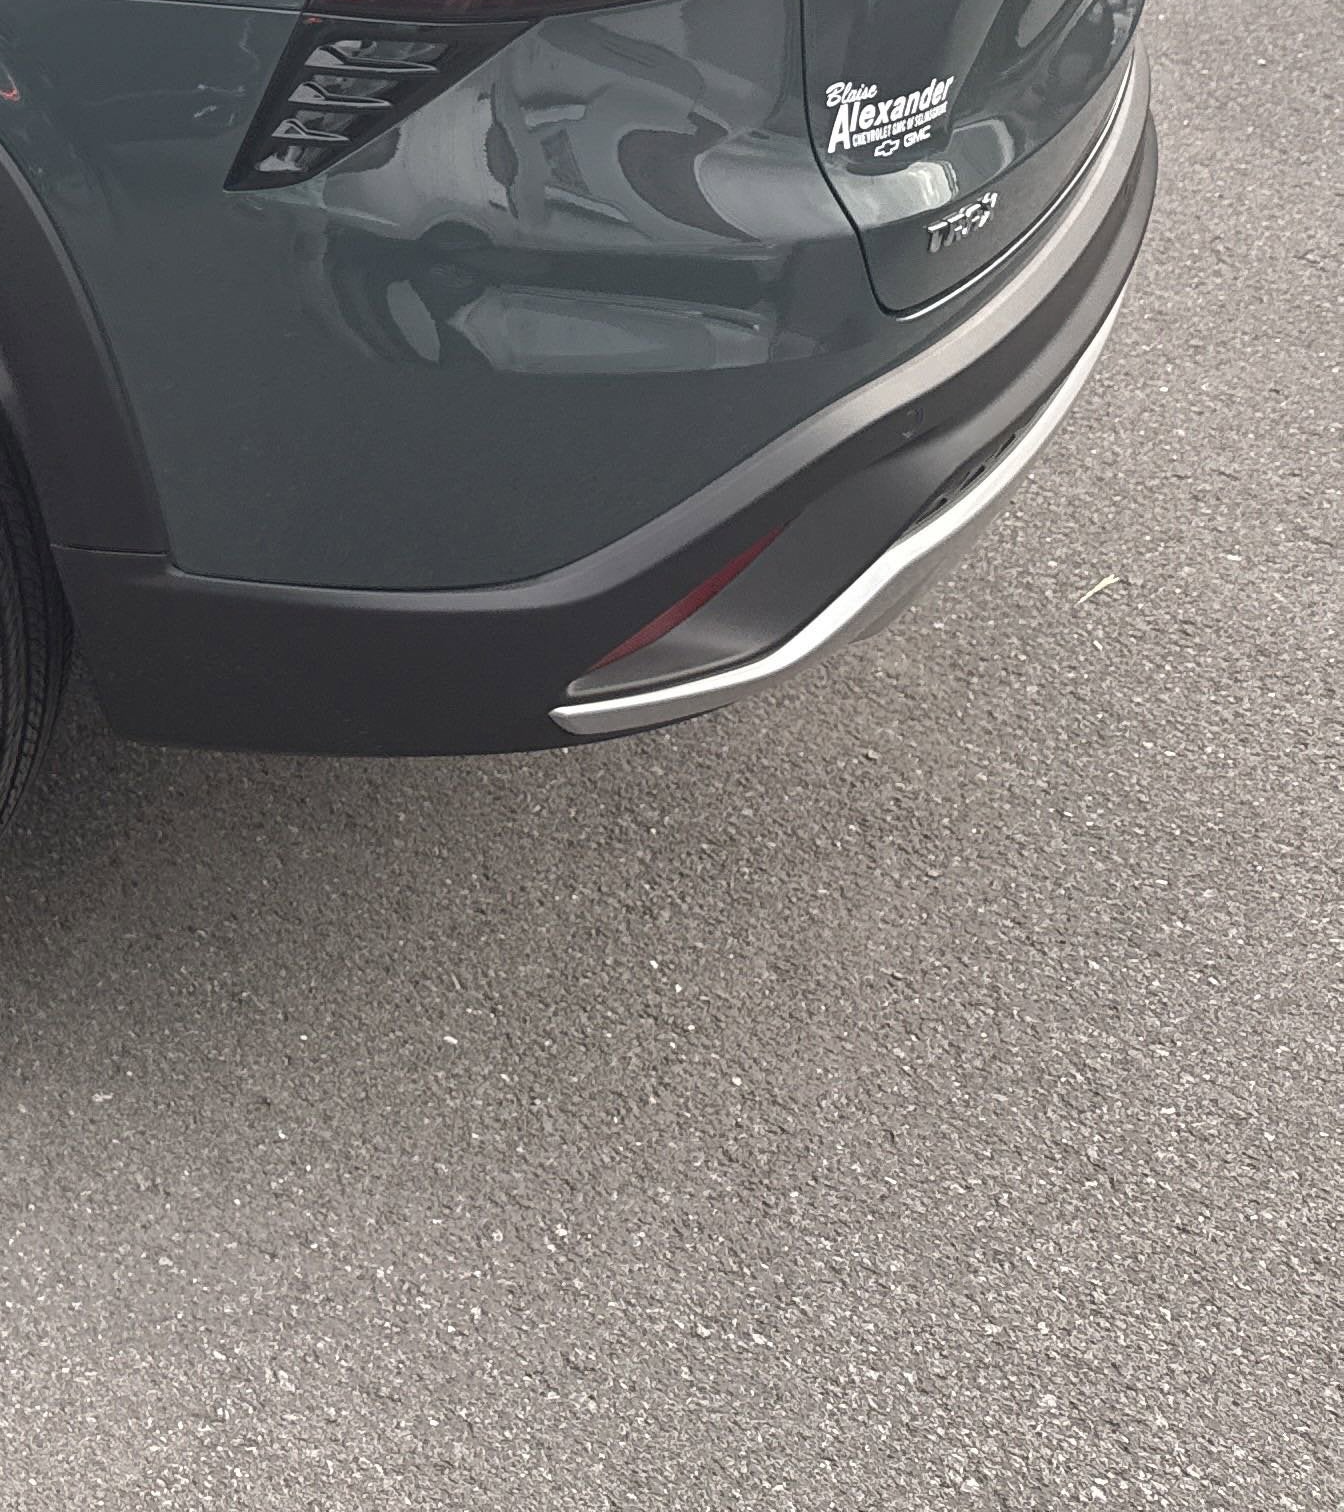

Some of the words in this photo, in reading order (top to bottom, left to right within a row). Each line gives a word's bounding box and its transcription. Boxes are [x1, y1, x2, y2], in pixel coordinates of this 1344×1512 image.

[825, 81, 878, 108] Blaise
[827, 75, 955, 154] Alexander
[852, 124, 892, 148] CHEVROLET
[903, 125, 932, 148] GMC
